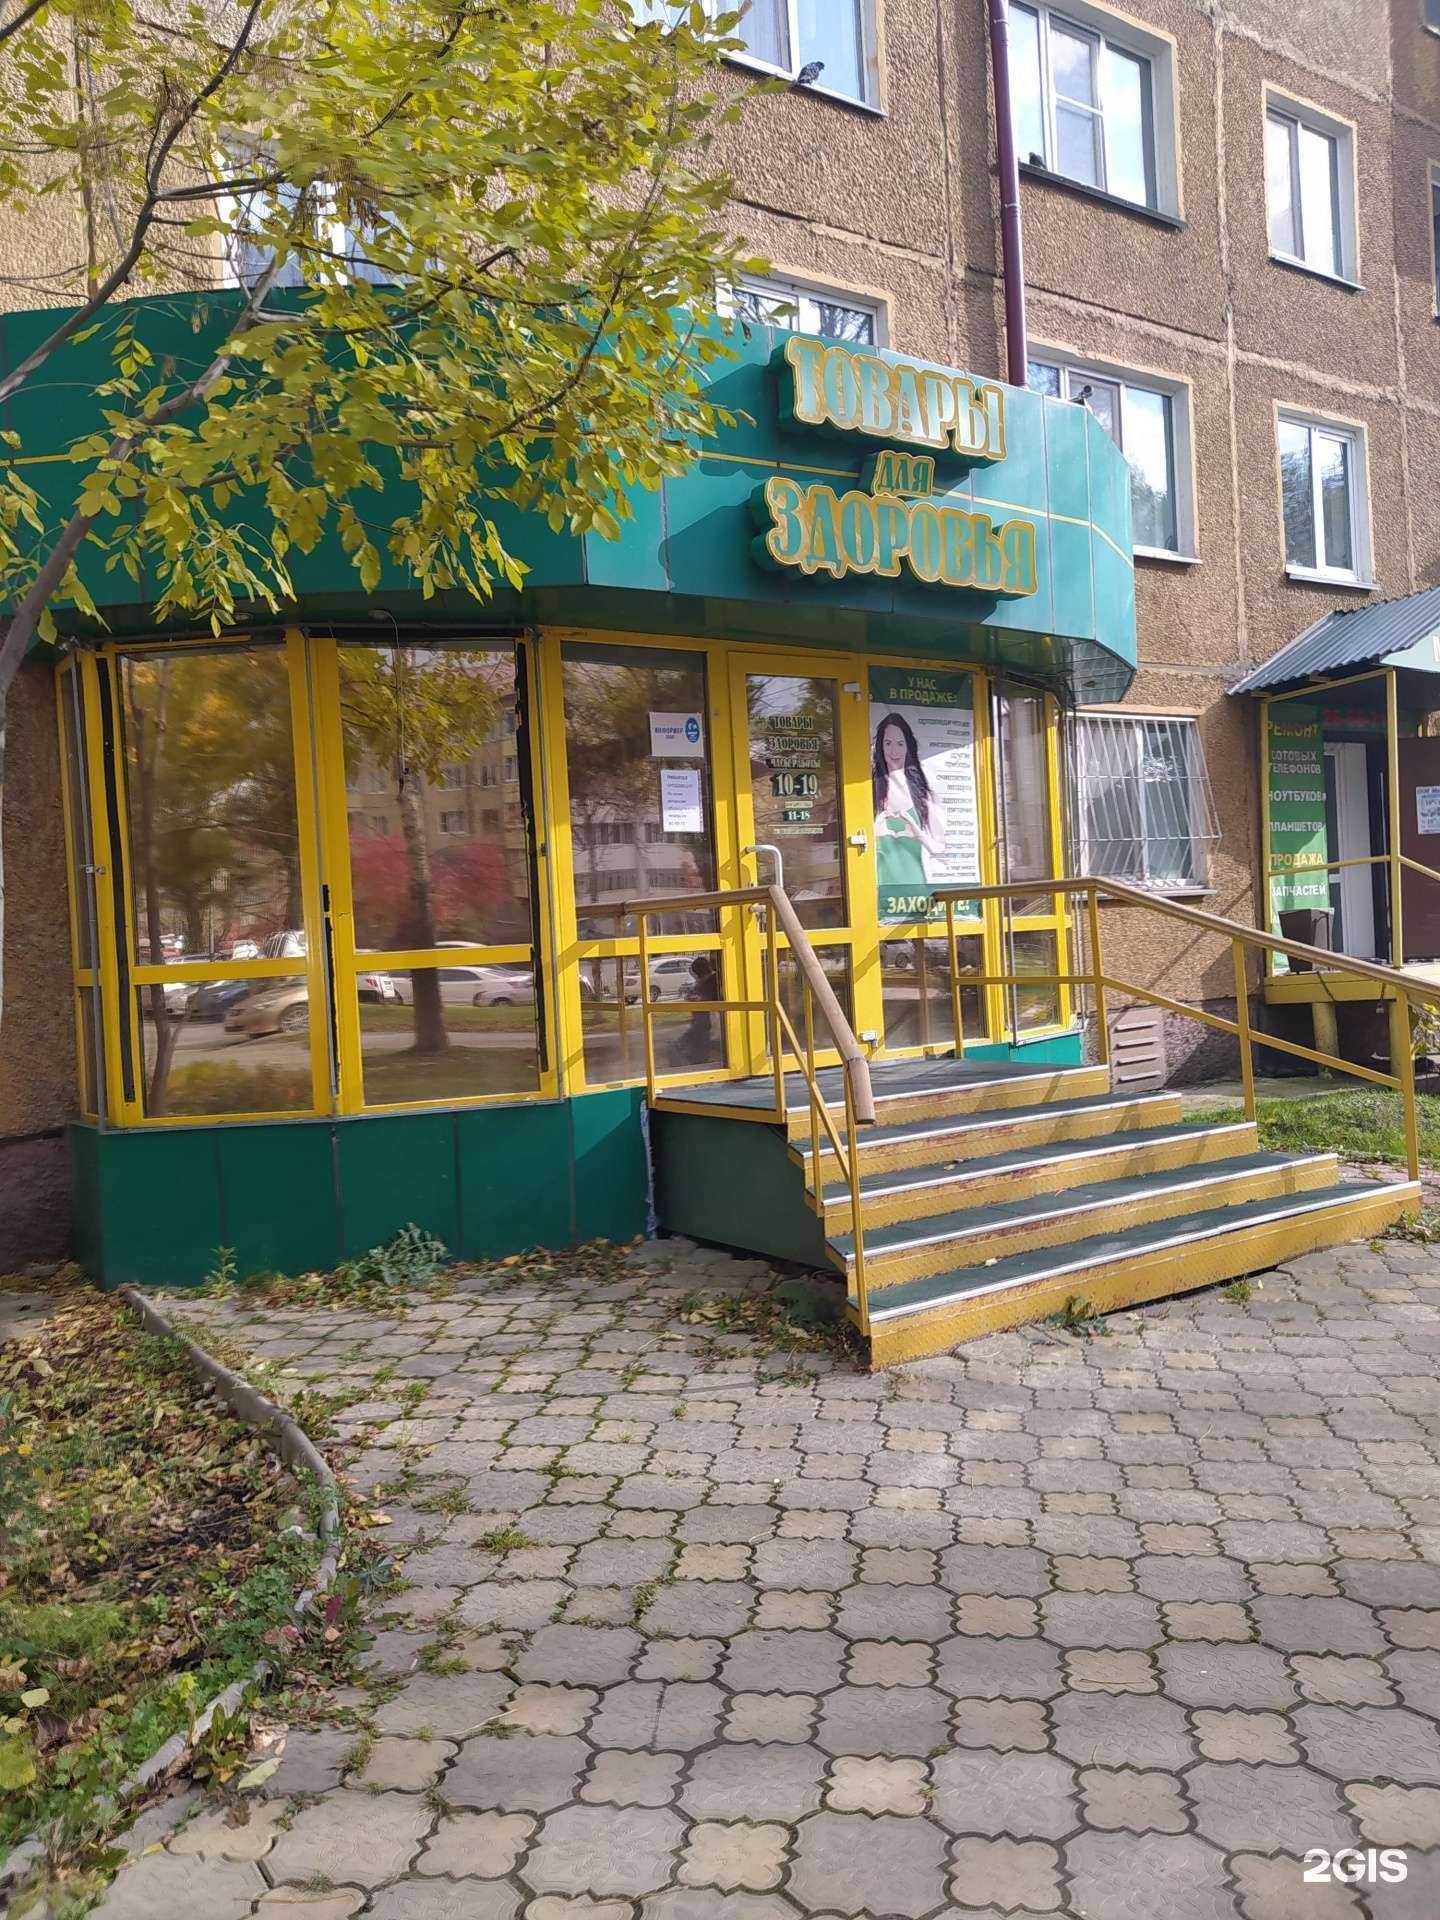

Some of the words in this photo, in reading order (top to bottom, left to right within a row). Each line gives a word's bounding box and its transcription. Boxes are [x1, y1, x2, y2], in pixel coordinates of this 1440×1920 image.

[787, 340, 1004, 457] ТОВАРЫ
[876, 453, 931, 495] ДЛЯ
[766, 480, 1037, 590] ЗДОРОВЬЯ
[909, 677, 914, 687] У
[917, 678, 937, 690] НАС
[889, 688, 897, 699] В
[774, 716, 813, 729] ТОВАРЫ
[768, 737, 819, 752] ЗДОРОВЬЯ
[1271, 750, 1317, 761] СОТОВЫХ
[776, 773, 818, 796] 10-19
[1270, 853, 1325, 867] ПРОДАЖА
[1271, 882, 1326, 897] ЗАПЧАСТЕЙ
